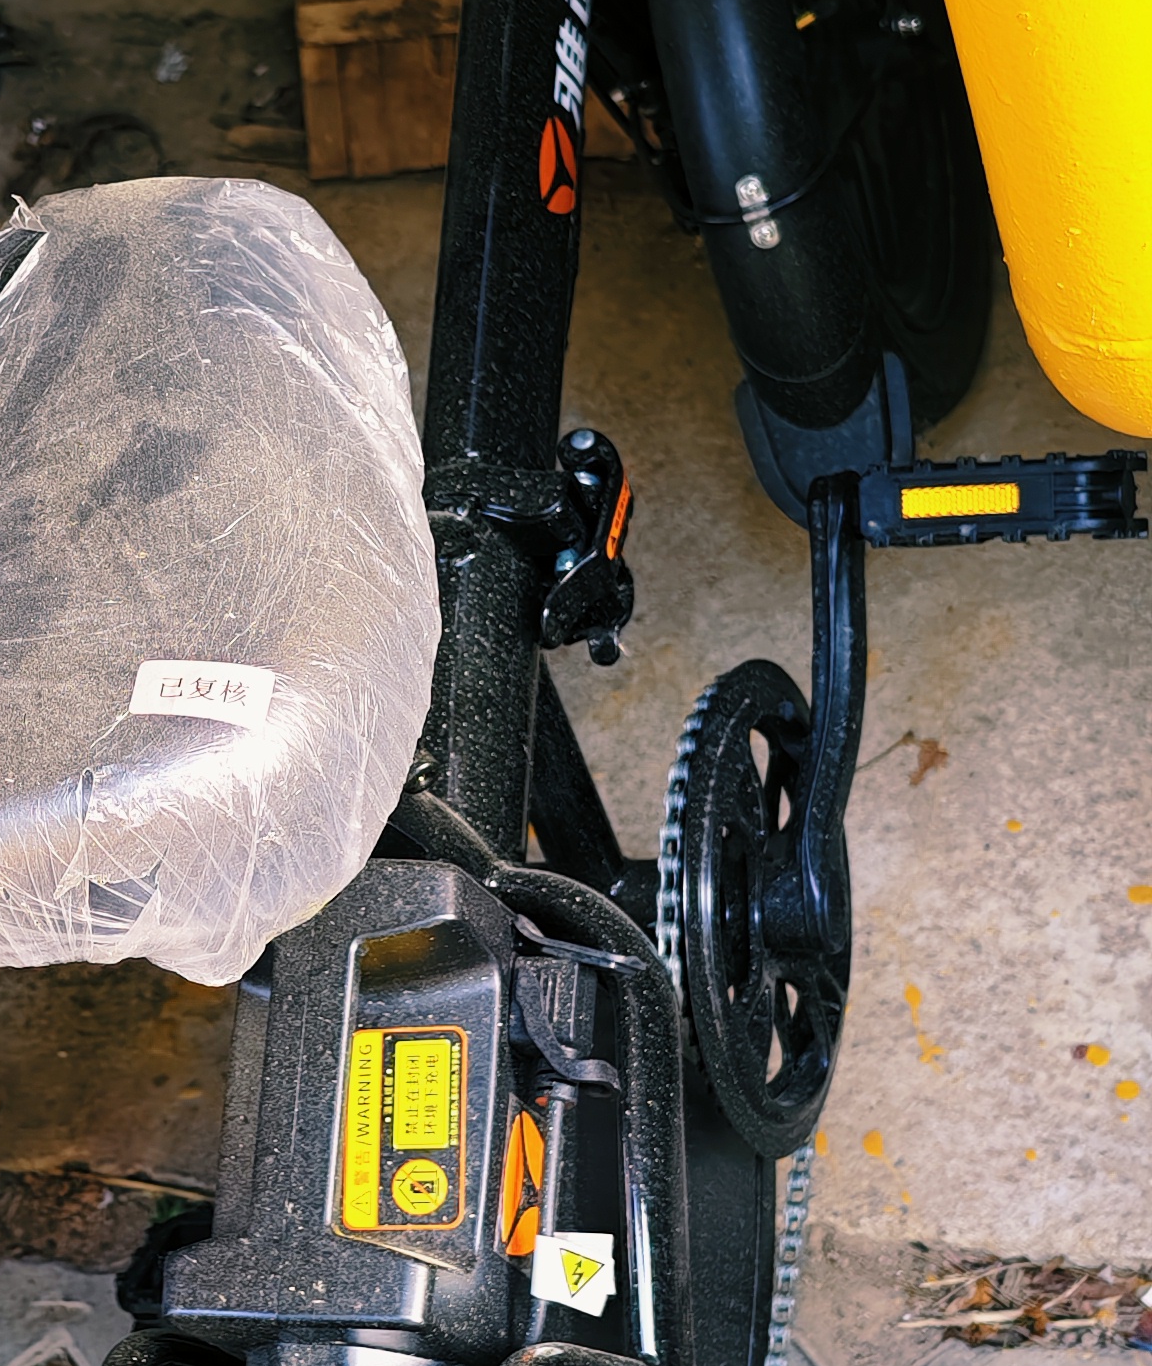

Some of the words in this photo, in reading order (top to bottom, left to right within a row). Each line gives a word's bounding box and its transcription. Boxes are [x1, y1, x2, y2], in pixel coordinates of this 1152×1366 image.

[159, 677, 249, 706] 已复核
[405, 1054, 421, 1135] 禁止在封闭
[423, 1053, 440, 1136] 环境下充电
